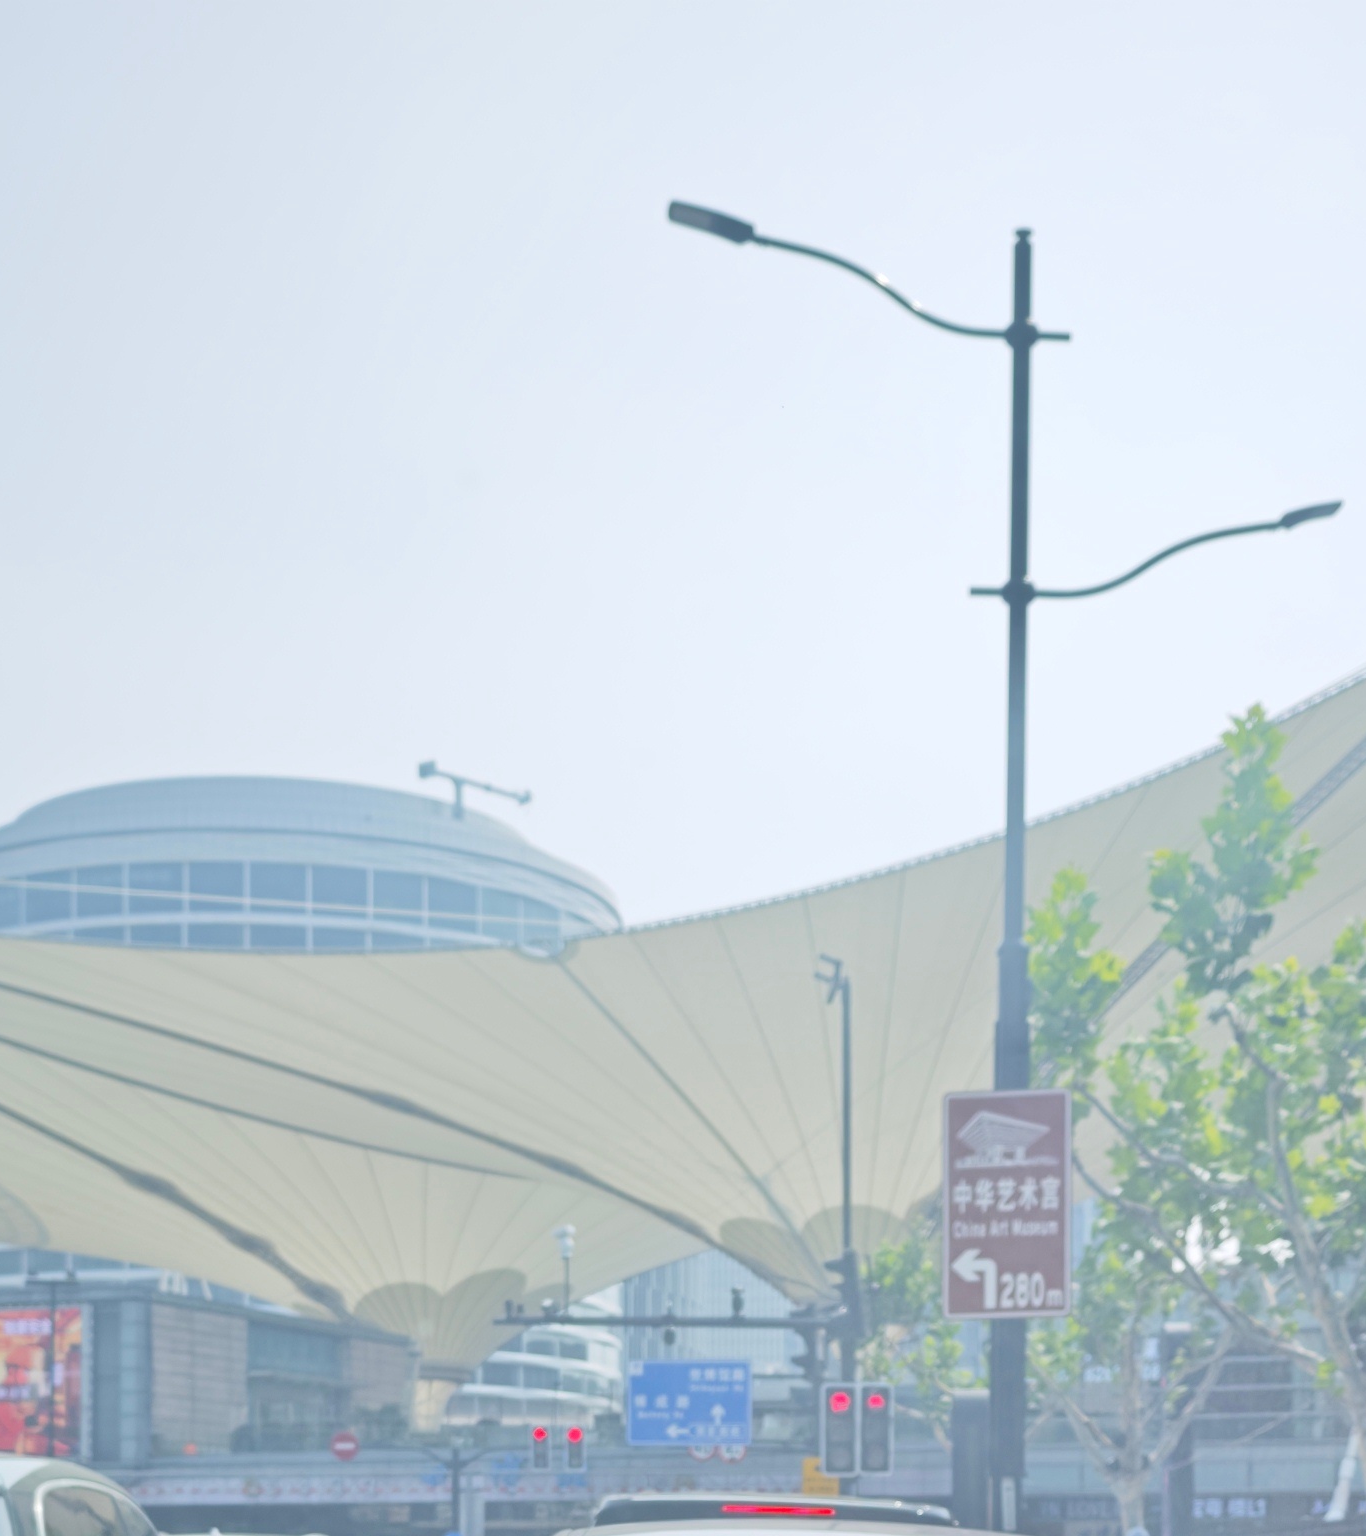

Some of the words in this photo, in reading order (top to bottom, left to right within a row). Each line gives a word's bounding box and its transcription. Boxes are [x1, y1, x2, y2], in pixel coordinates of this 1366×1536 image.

[952, 1175, 1061, 1214] 中华艺术宫
[952, 1219, 987, 1239] China
[989, 1218, 1010, 1237] Art
[1011, 1218, 1059, 1237] Museum
